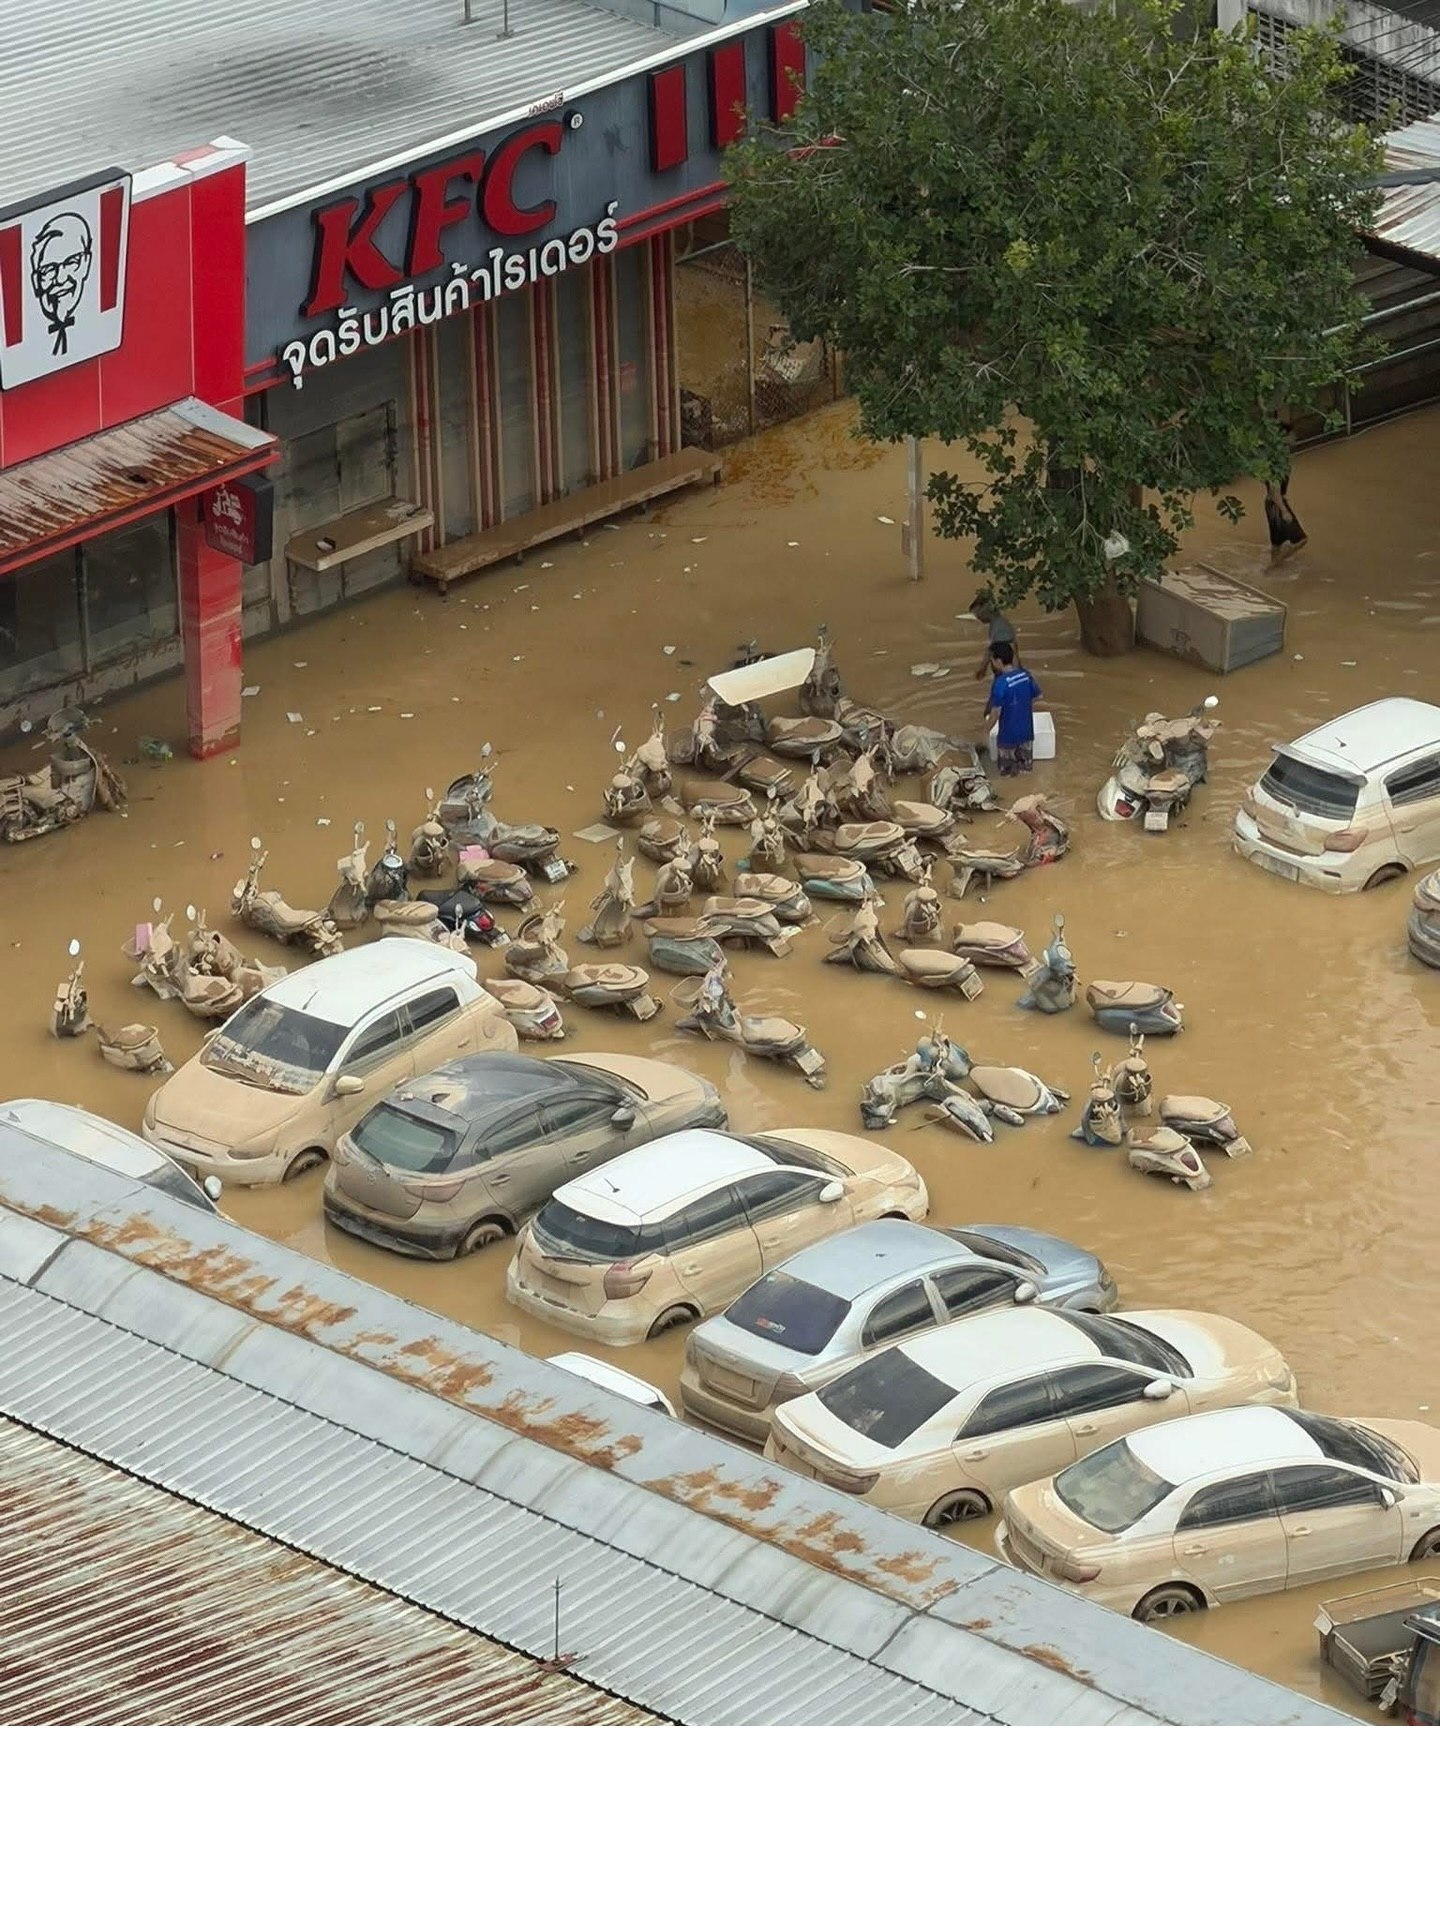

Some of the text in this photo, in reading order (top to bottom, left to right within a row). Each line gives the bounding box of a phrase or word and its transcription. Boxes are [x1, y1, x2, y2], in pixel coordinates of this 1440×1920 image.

[282, 201, 619, 390] จุดรับสินค้าไรเดอร์
[301, 120, 565, 318] KFC
